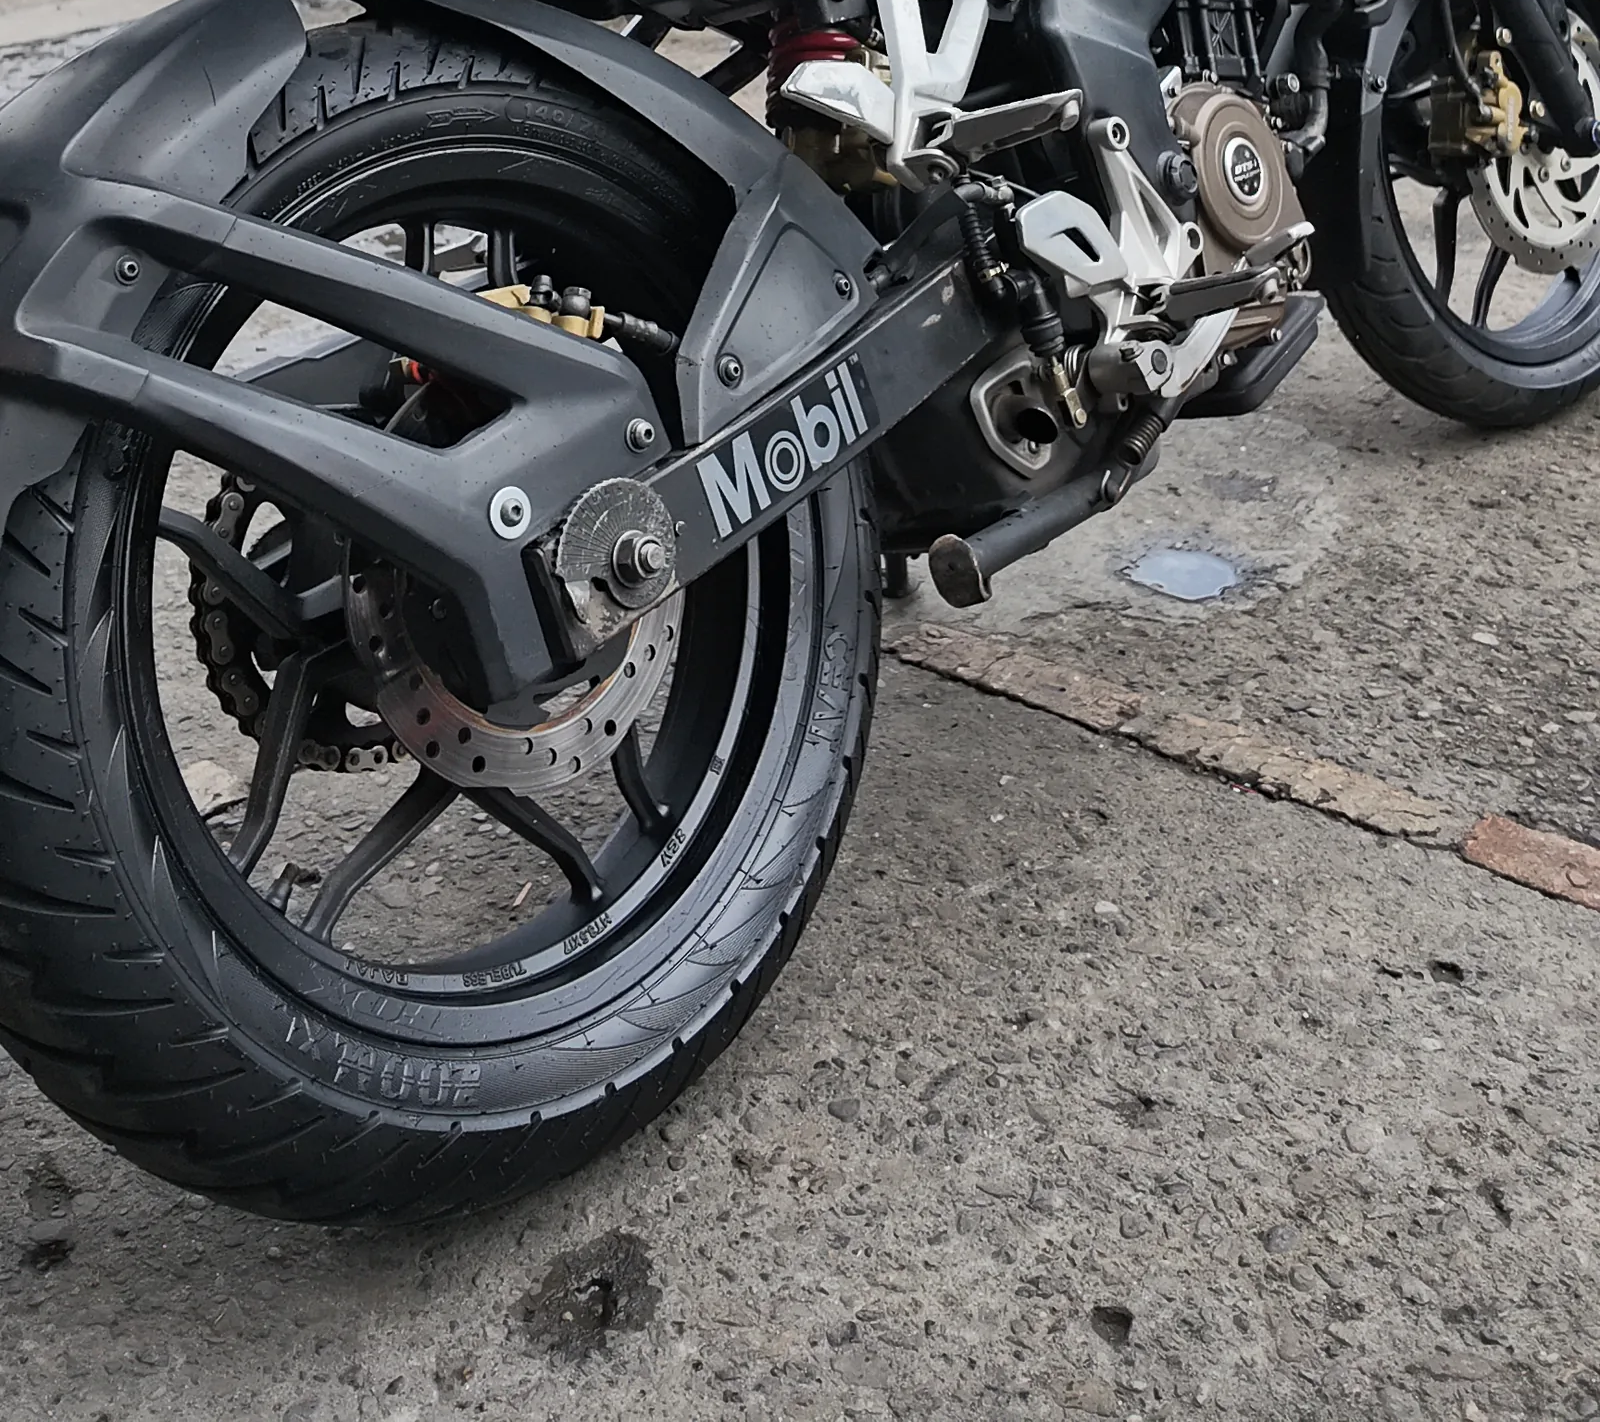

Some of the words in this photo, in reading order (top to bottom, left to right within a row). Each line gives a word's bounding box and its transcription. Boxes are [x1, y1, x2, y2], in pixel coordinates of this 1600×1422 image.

[695, 362, 869, 539] Mobil
[343, 959, 409, 986] BAJAJ
[462, 962, 527, 987] TUBELESS
